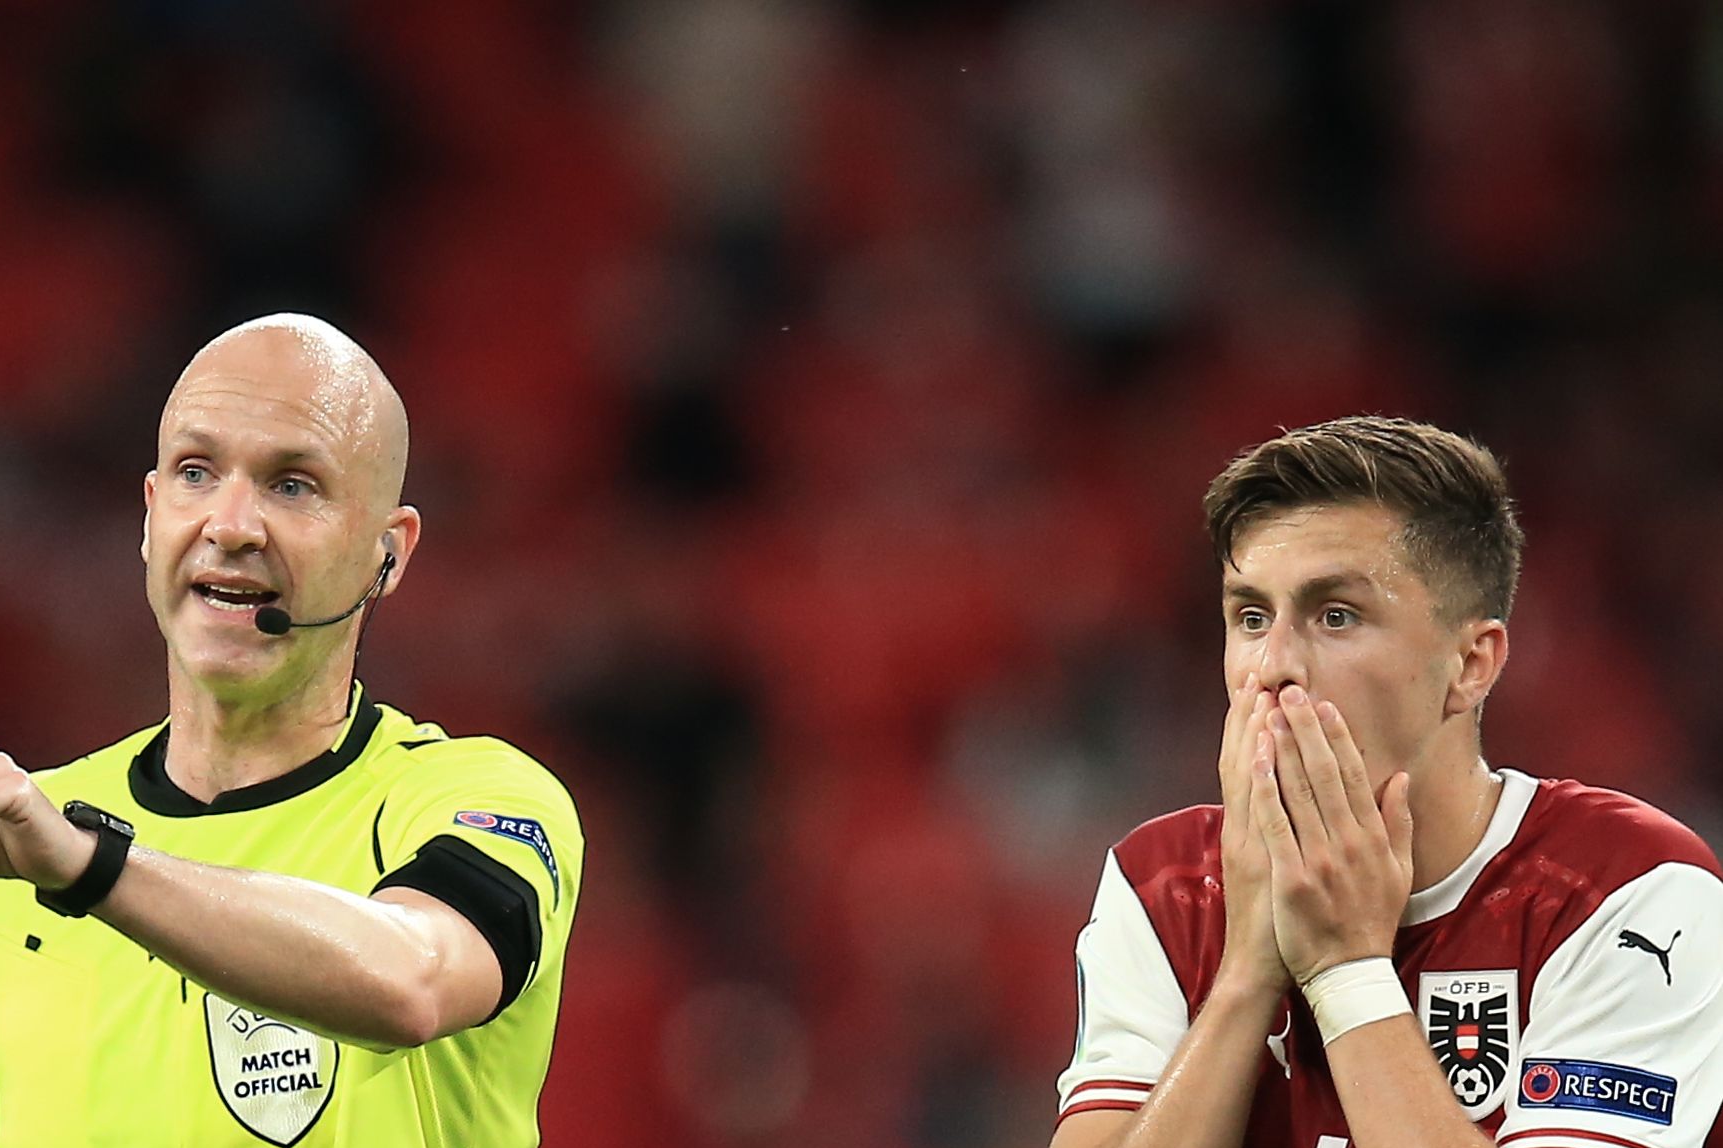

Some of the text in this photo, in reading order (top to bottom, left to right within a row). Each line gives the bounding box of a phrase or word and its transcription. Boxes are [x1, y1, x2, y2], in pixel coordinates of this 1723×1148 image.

[1450, 980, 1490, 995] ÖFB
[241, 1047, 312, 1074] MATCH
[233, 1071, 324, 1099] OFFICIAL
[1564, 1074, 1675, 1113] RESPECT
